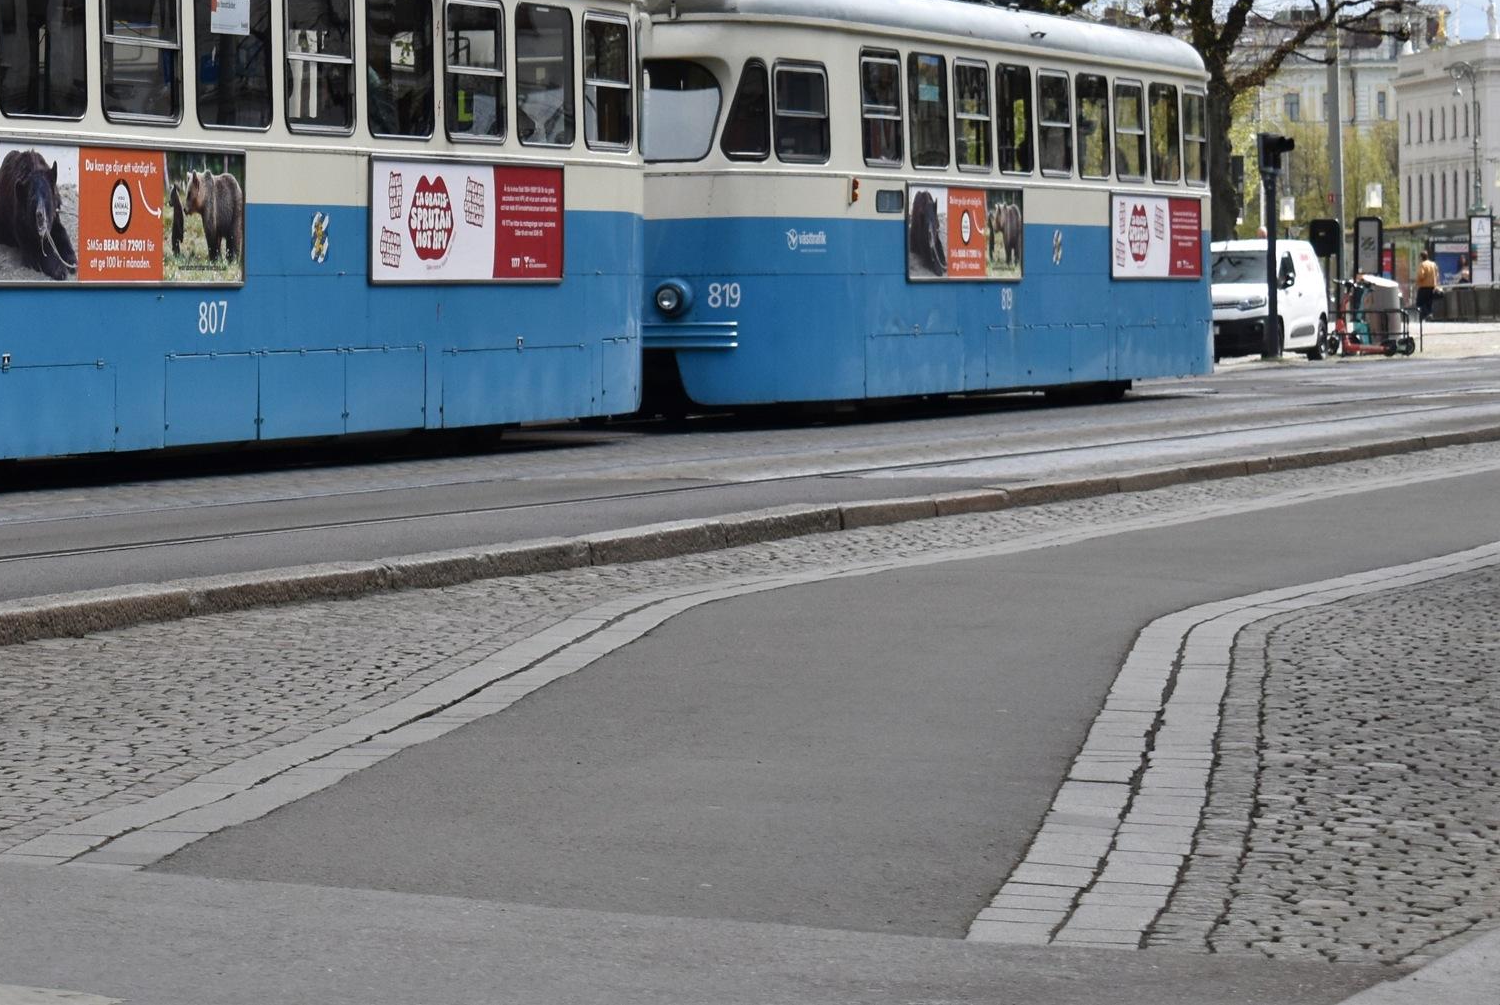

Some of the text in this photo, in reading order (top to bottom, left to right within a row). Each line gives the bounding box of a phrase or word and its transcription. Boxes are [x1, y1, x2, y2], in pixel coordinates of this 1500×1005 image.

[85, 159, 94, 171] Du
[94, 159, 104, 172] kan
[105, 163, 112, 176] ge
[416, 192, 449, 208] TA GRATIS-
[410, 206, 452, 231] SPRUTAN
[103, 239, 119, 251] BEAR
[128, 239, 145, 251] 72901
[416, 229, 448, 250] MOT HPV
[106, 256, 116, 268] 100
[707, 283, 741, 308] 819
[198, 301, 228, 334] 807
